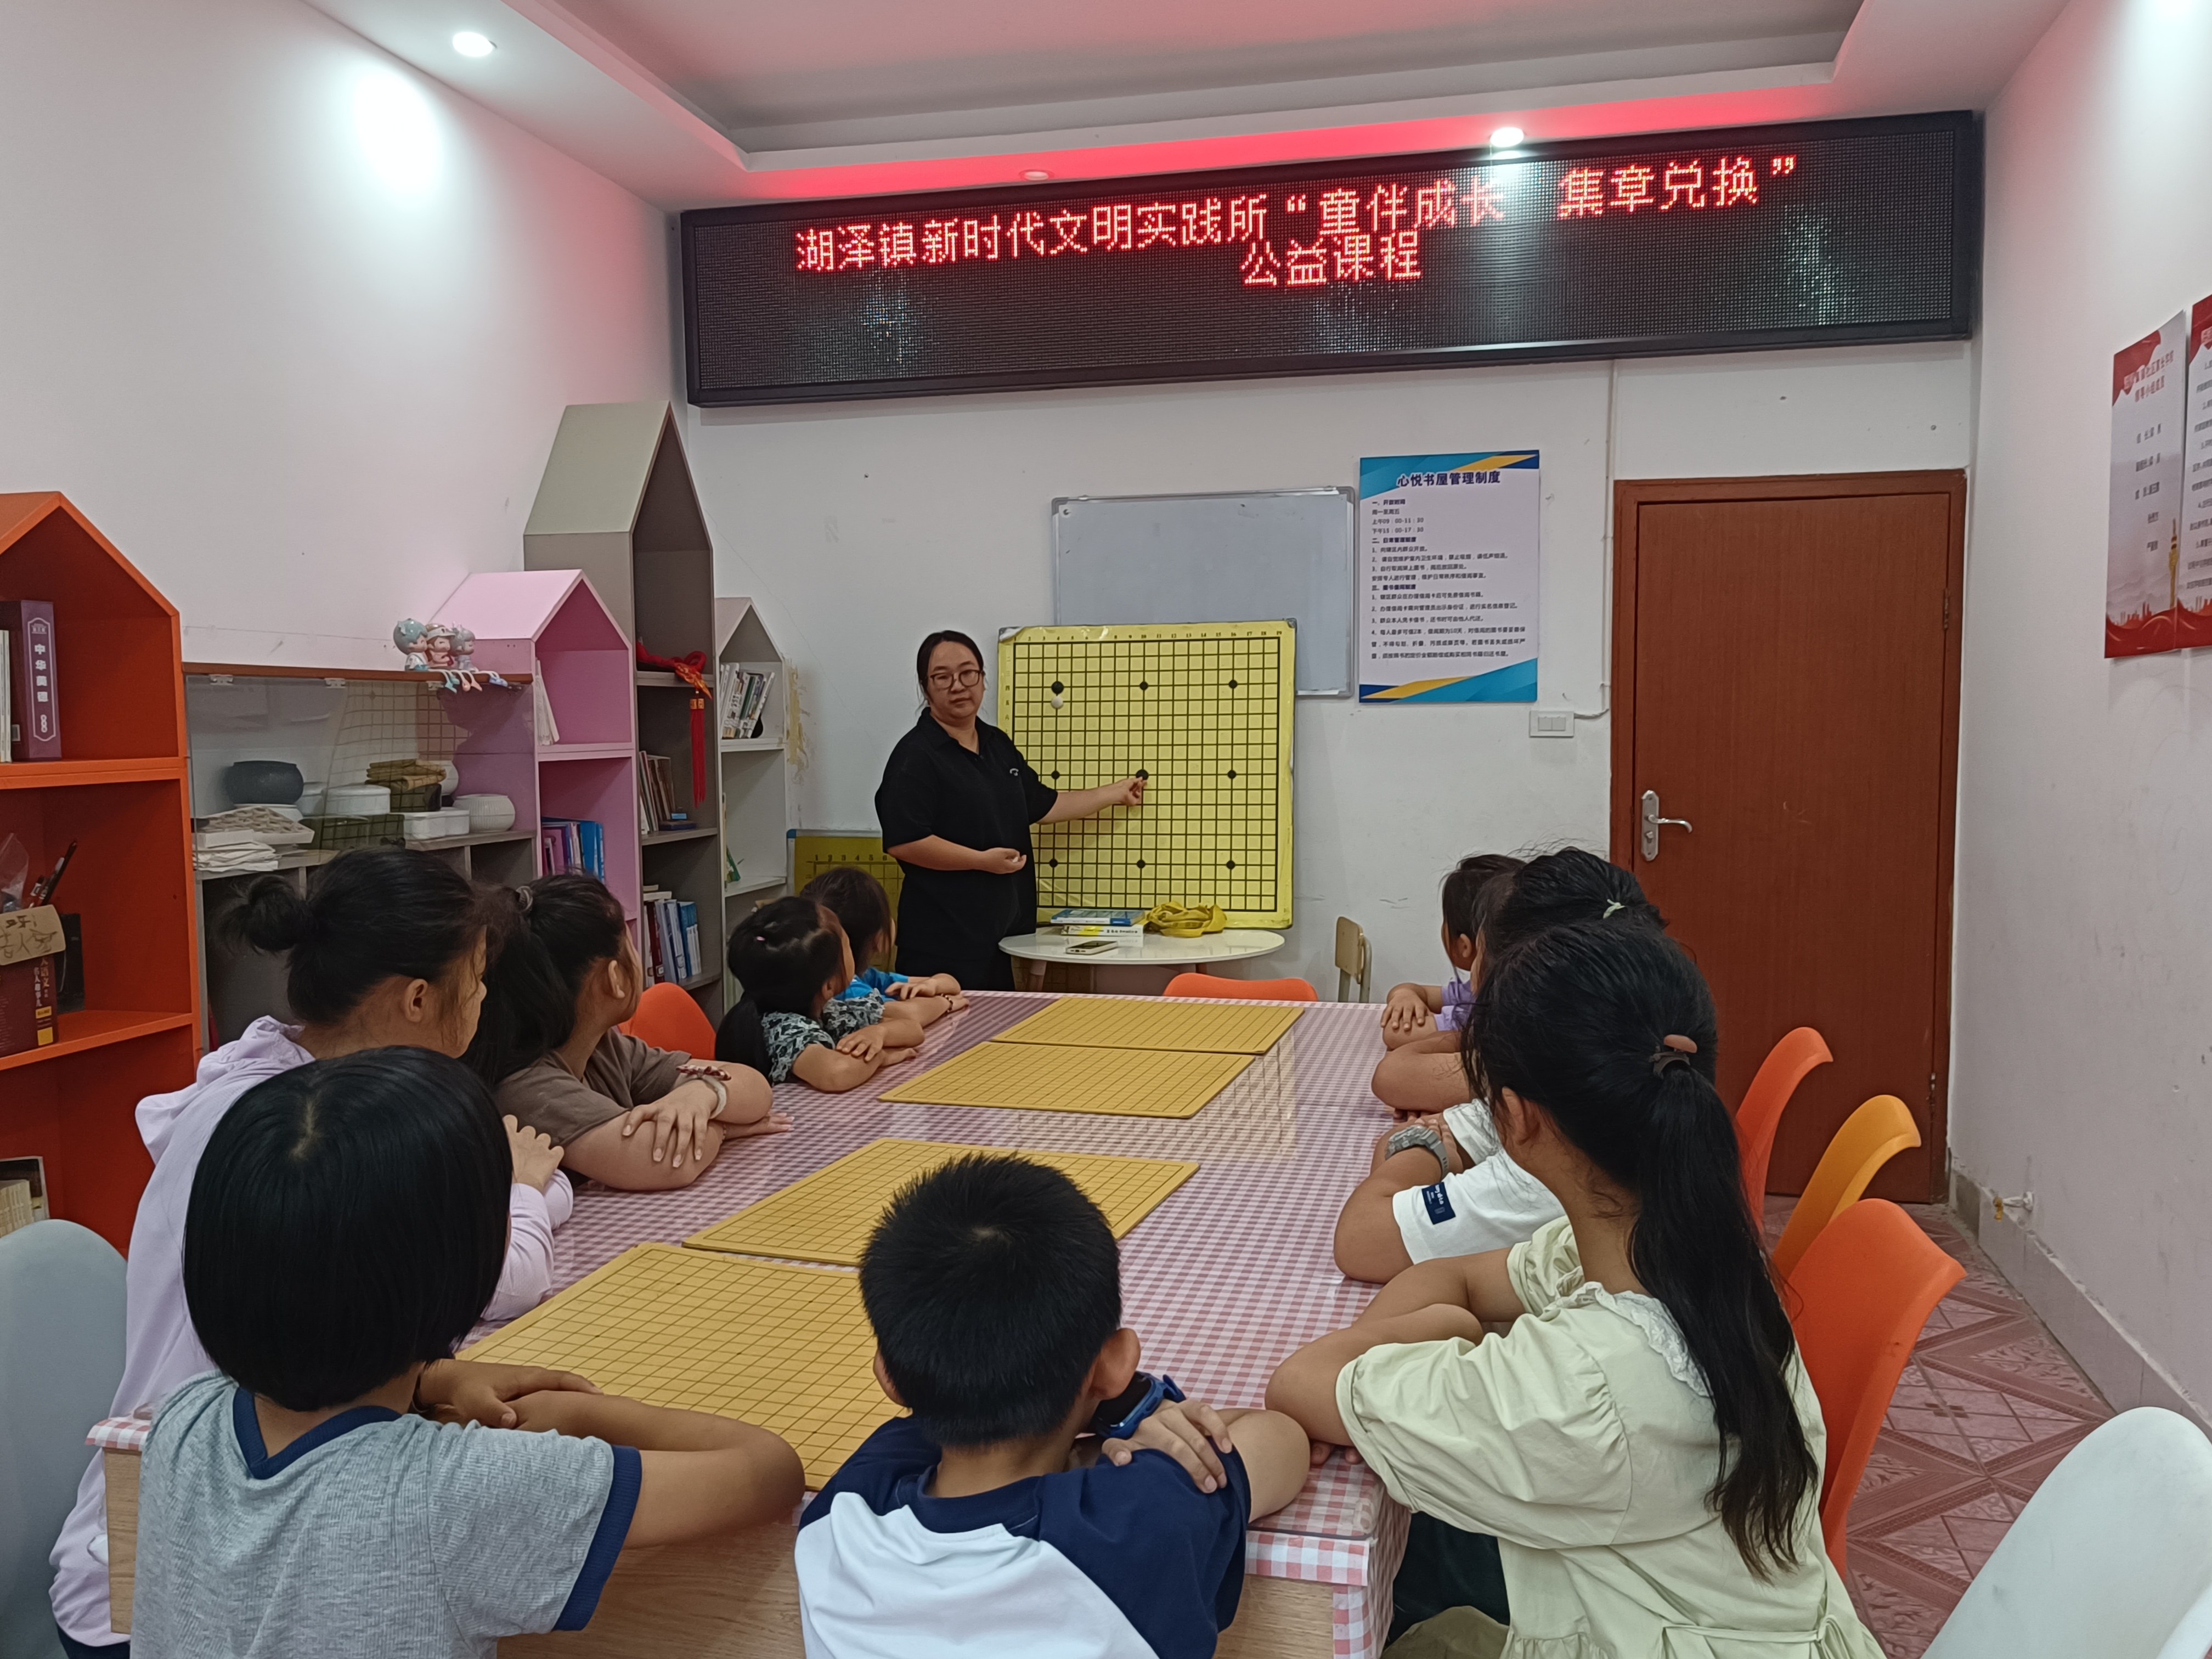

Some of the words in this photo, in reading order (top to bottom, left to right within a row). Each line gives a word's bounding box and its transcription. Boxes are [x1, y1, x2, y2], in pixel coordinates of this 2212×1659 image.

[1240, 230, 1422, 286] 公益课程
[1397, 470, 1501, 487] 心悦书屋管理制度
